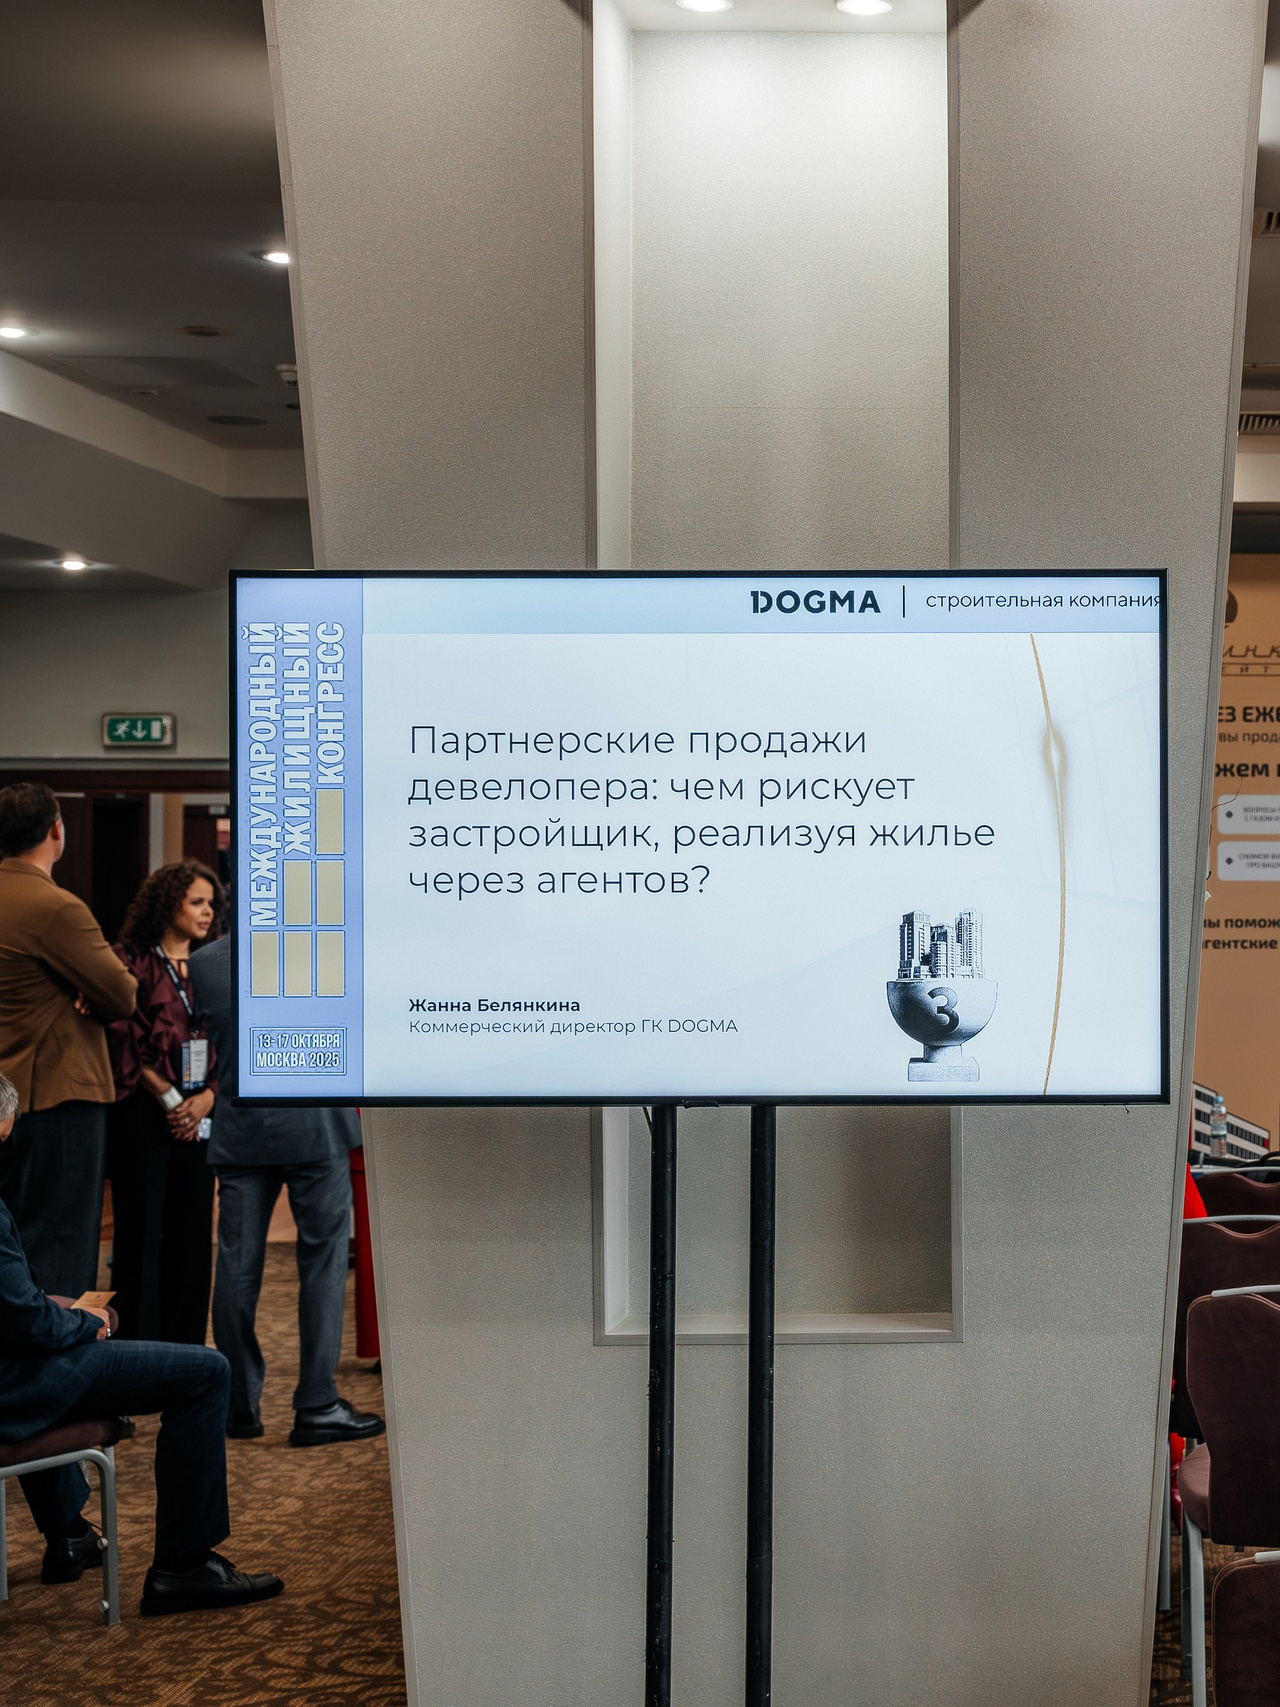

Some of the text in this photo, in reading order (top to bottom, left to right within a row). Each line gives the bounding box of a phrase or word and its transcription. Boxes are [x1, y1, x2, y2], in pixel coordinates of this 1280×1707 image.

[751, 590, 881, 614] DOGMA
[926, 593, 1163, 611] строительная компания
[316, 621, 346, 784] КОНГРЕСС
[276, 622, 315, 854] ЖИЛИЩНЫЙ
[411, 725, 867, 760] Партнерские продажи
[1219, 733, 1238, 743] вы
[242, 622, 281, 926] МЕЖДУНАРОДНЫЙ
[408, 777, 915, 807] девелопера: чем рискует
[409, 817, 995, 854] застройщик, реализуя жилье
[409, 864, 710, 900] через агентов?
[409, 998, 580, 1013] Жанна Белянкина
[409, 1018, 739, 1035] Коммерческий директор ГК DOGMA
[257, 1033, 340, 1050] 13-17 ОКТЯБРЯ
[256, 1052, 340, 1068] МОСКВА 2025
